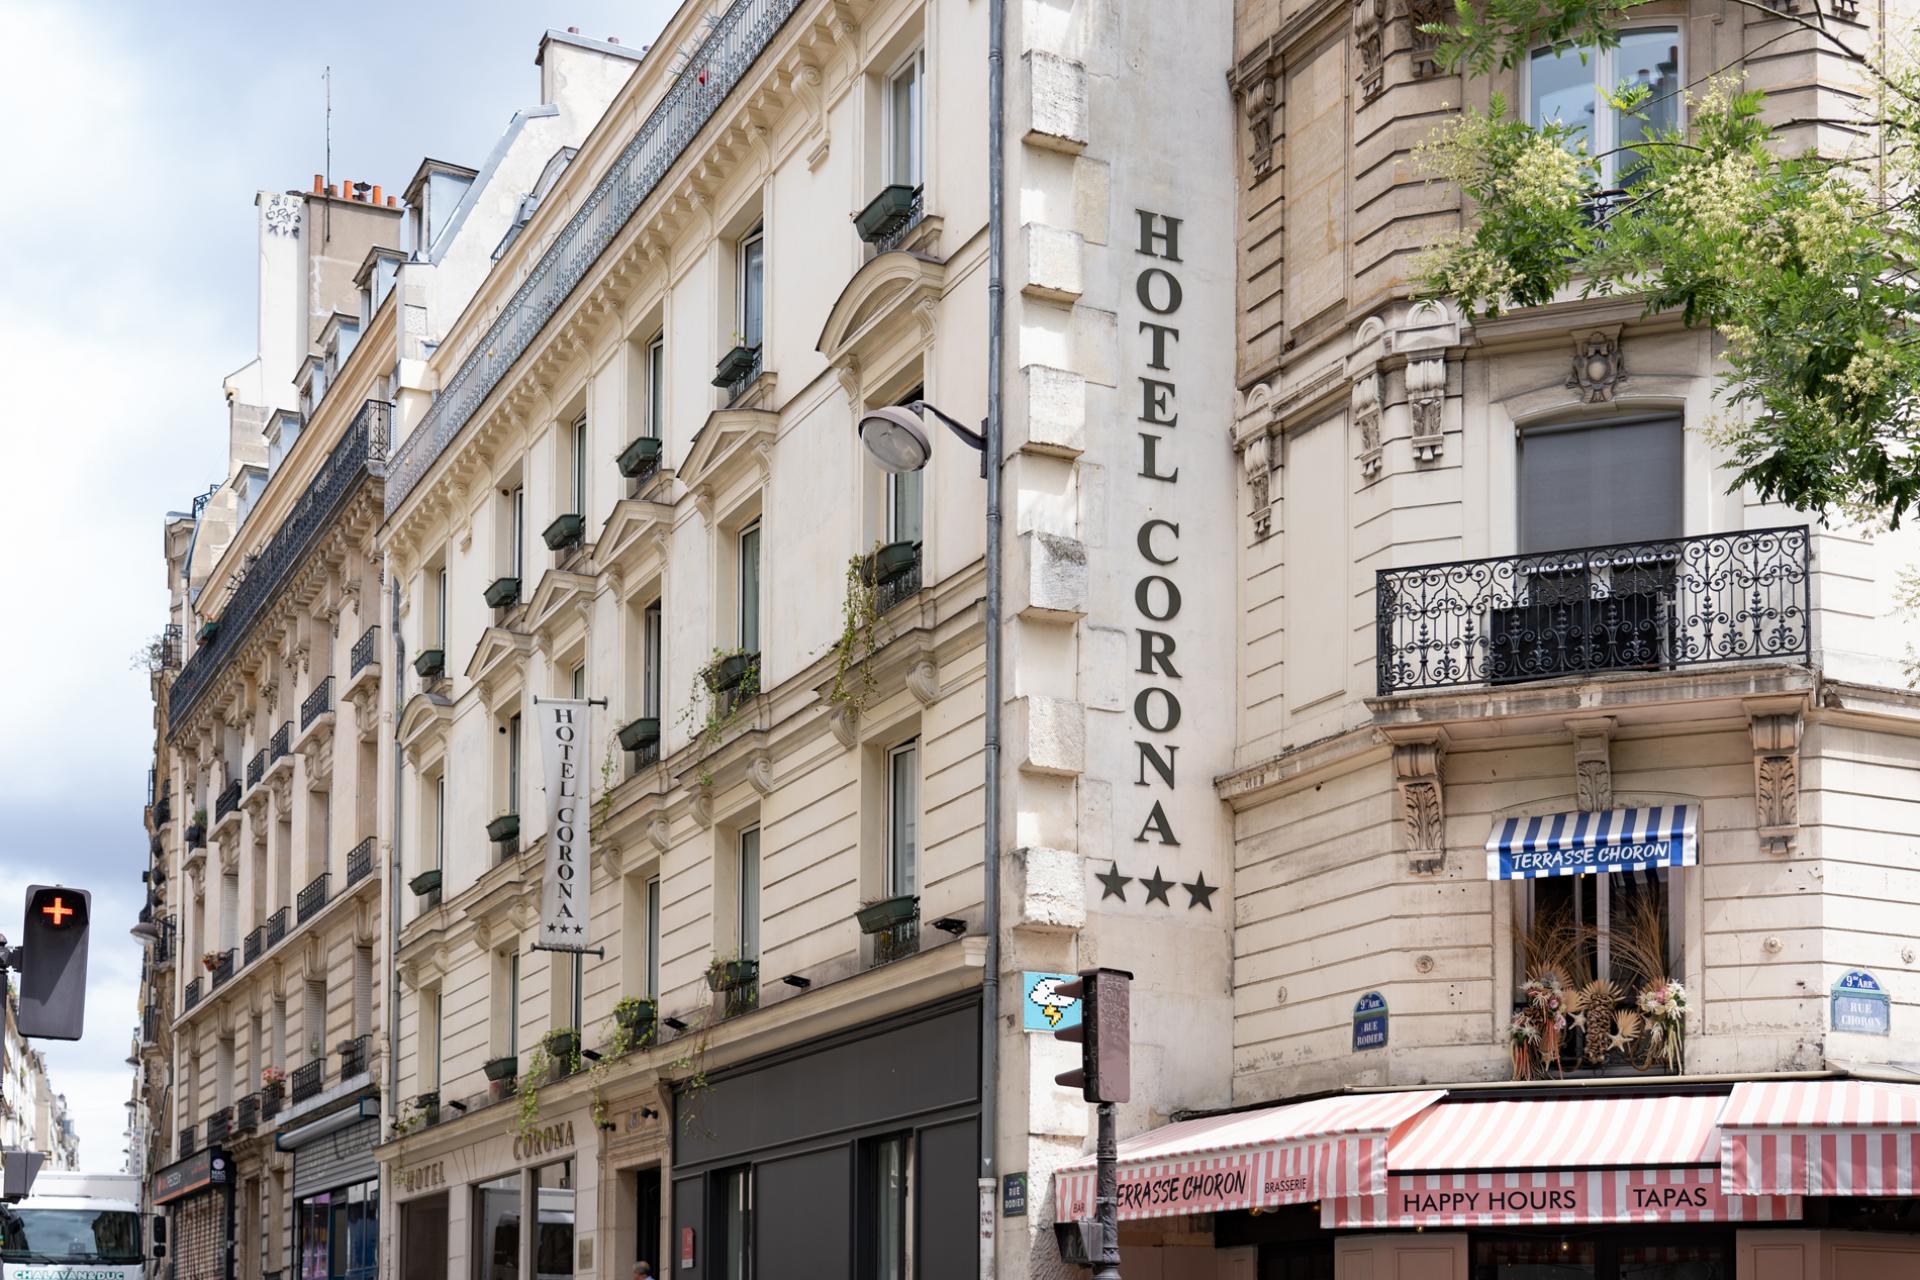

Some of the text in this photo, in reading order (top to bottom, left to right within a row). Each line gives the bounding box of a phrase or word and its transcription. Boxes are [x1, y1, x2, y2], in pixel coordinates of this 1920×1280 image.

[1133, 208, 1184, 846] HOTEL CORONA
[554, 708, 575, 919] HOTEL CORONA
[1511, 842, 1669, 870] TERRASSE CHORON
[1850, 1002, 1872, 1013] RUE
[1364, 1021, 1378, 1032] RUE
[1841, 1014, 1881, 1026] CHORON
[406, 1120, 576, 1193] HOTEL CORONA
[1116, 1169, 1247, 1209] ERRASSE CHORON
[1264, 1178, 1307, 1194] BRASSERIE
[1403, 1190, 1576, 1212] HAPPY HOURS
[1633, 1187, 1707, 1208] TAPAS
[1073, 1203, 1085, 1214] BAR
